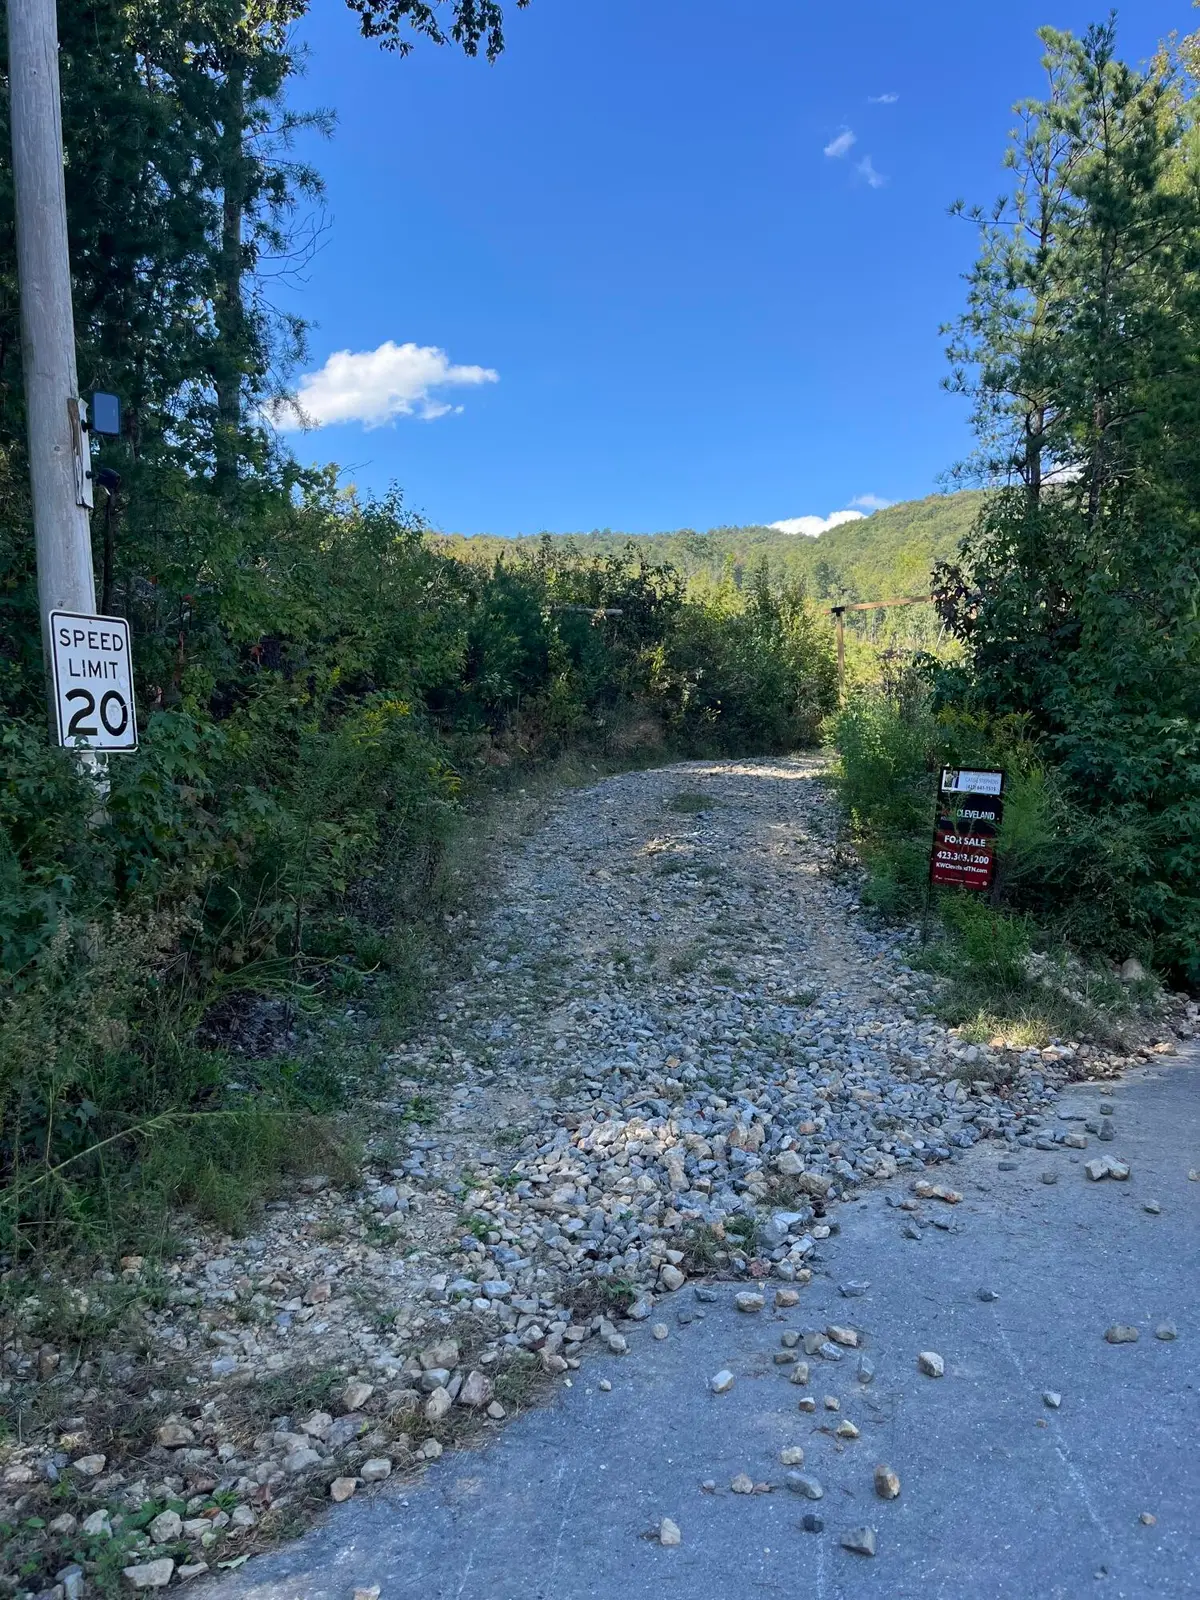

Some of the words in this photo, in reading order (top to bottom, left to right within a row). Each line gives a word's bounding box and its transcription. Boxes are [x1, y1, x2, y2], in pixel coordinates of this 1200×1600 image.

[59, 628, 124, 652] SPEED
[68, 658, 118, 679] LIMIT
[65, 688, 129, 738] 20
[956, 809, 995, 821] CLEVELAND
[944, 835, 962, 845] FOR
[964, 837, 986, 847] SALE
